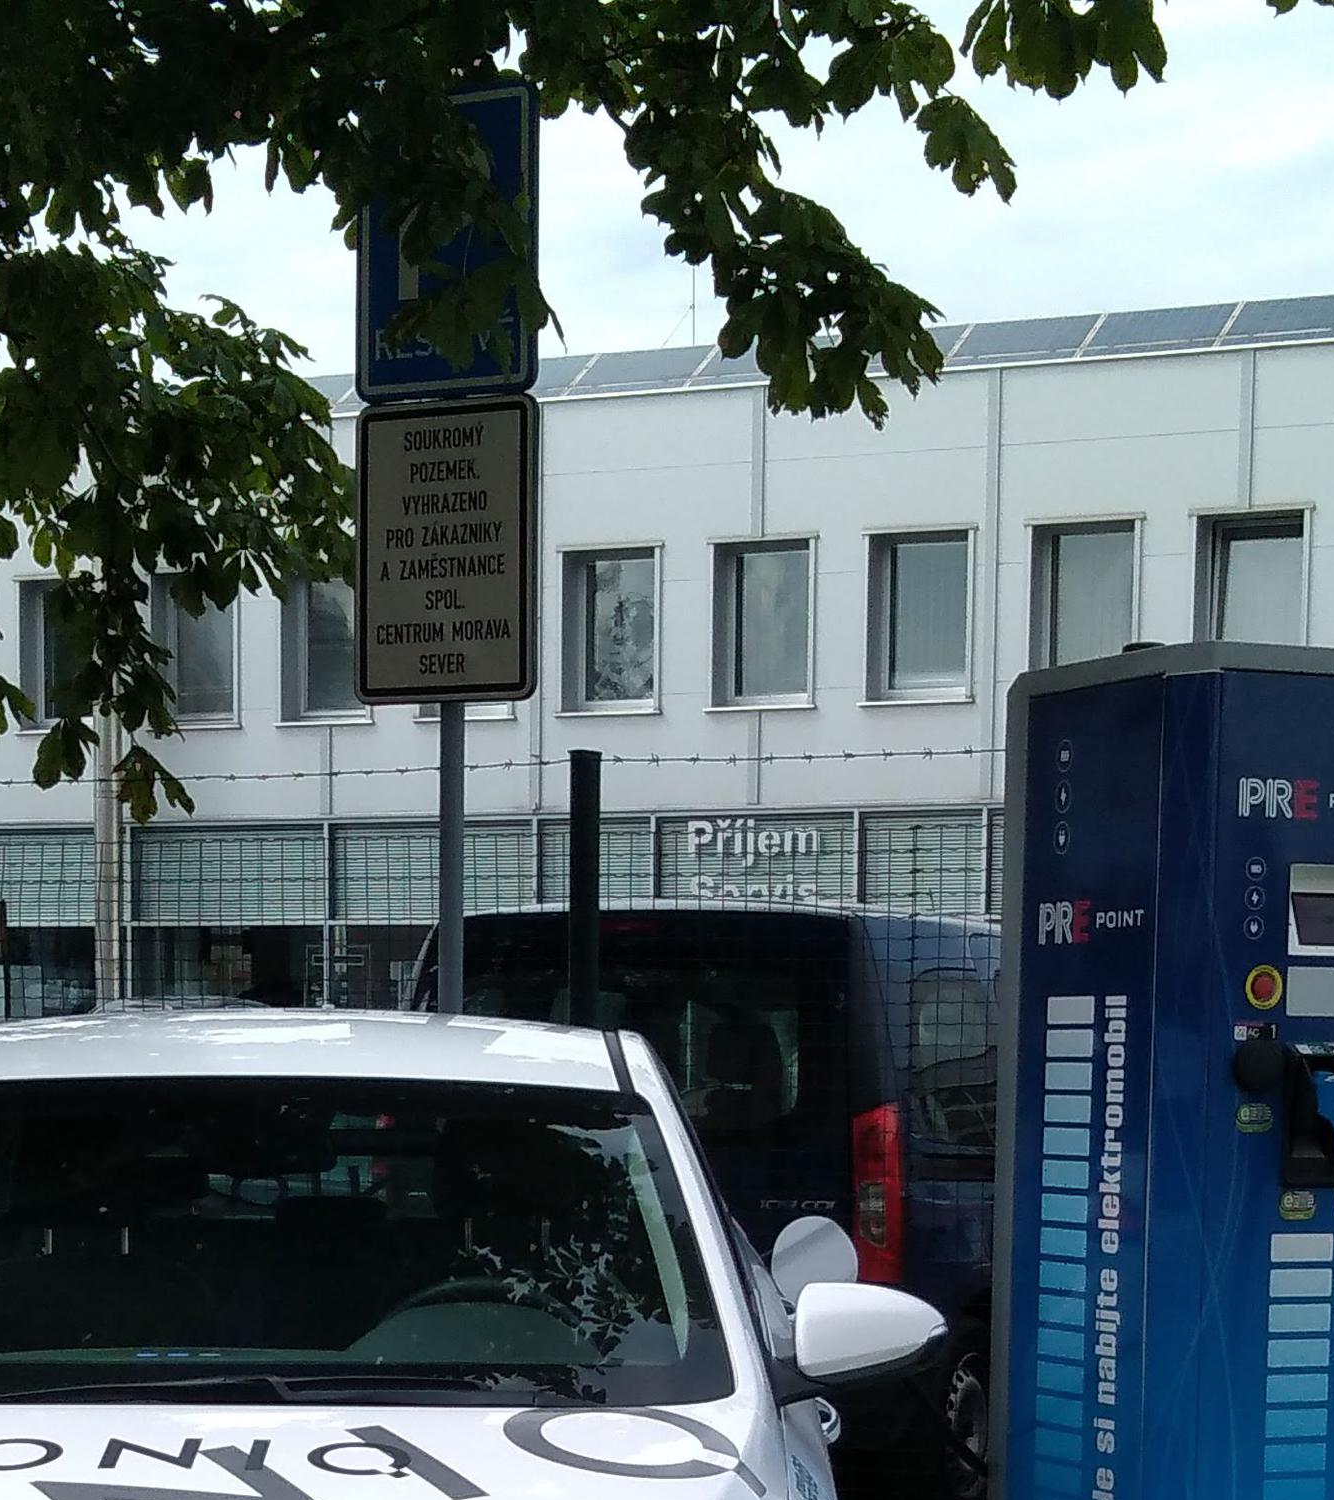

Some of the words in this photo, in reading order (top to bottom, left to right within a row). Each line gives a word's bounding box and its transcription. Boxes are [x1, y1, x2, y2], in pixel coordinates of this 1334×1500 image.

[404, 421, 484, 452] SOUKROMÝ
[410, 459, 480, 483] POZEMEK.
[402, 490, 488, 516] VYHRAZENO
[386, 527, 415, 549] PRO
[380, 561, 391, 582] A
[399, 553, 506, 581] ZAMĚSTNANCE
[424, 589, 466, 610] SPOL.
[376, 622, 444, 645] CENTRUM
[451, 618, 511, 642] MORAVA
[419, 653, 466, 675] SEVER
[1238, 777, 1320, 820] PRE
[687, 818, 818, 867] Příjem
[1038, 900, 1091, 945] PRE
[1096, 909, 1145, 928] POINT
[1098, 995, 1127, 1255] elektromobil
[1095, 1268, 1120, 1406] nabijte
[1094, 1417, 1116, 1454] si
